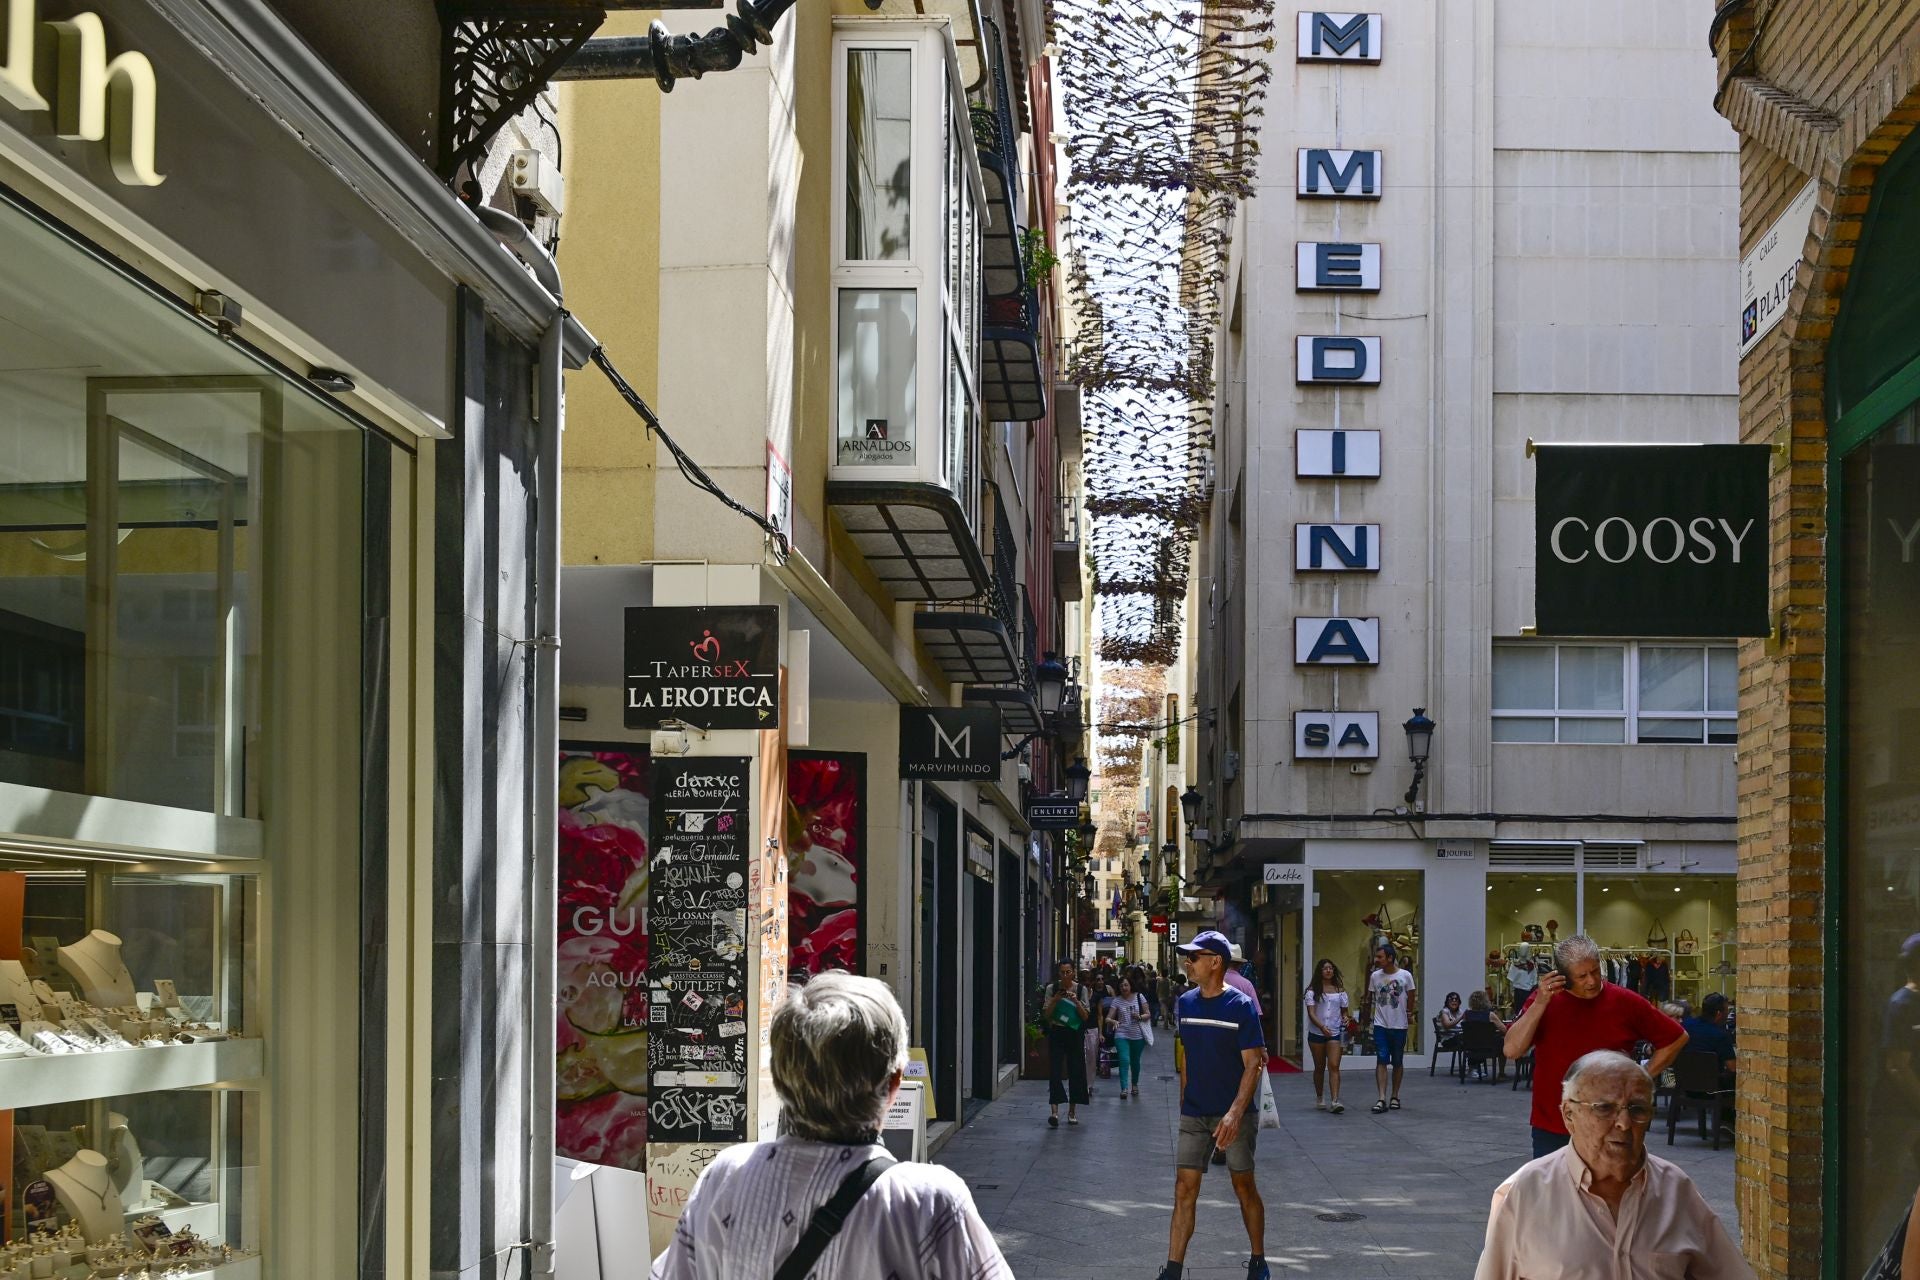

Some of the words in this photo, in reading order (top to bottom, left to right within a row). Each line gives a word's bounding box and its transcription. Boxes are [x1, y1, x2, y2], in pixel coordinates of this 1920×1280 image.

[1312, 12, 1369, 57] M
[1760, 231, 1778, 261] CALLE
[842, 440, 912, 452] ARNALDOS
[860, 453, 893, 461] abogados
[1550, 516, 1755, 564] COOSY
[628, 687, 655, 708] LA
[661, 686, 774, 708] EROTECA
[1304, 723, 1369, 747] SA
[909, 763, 991, 774] MARVIMUNDO
[1265, 868, 1303, 881] Anekke
[669, 980, 725, 991] OUTLET
